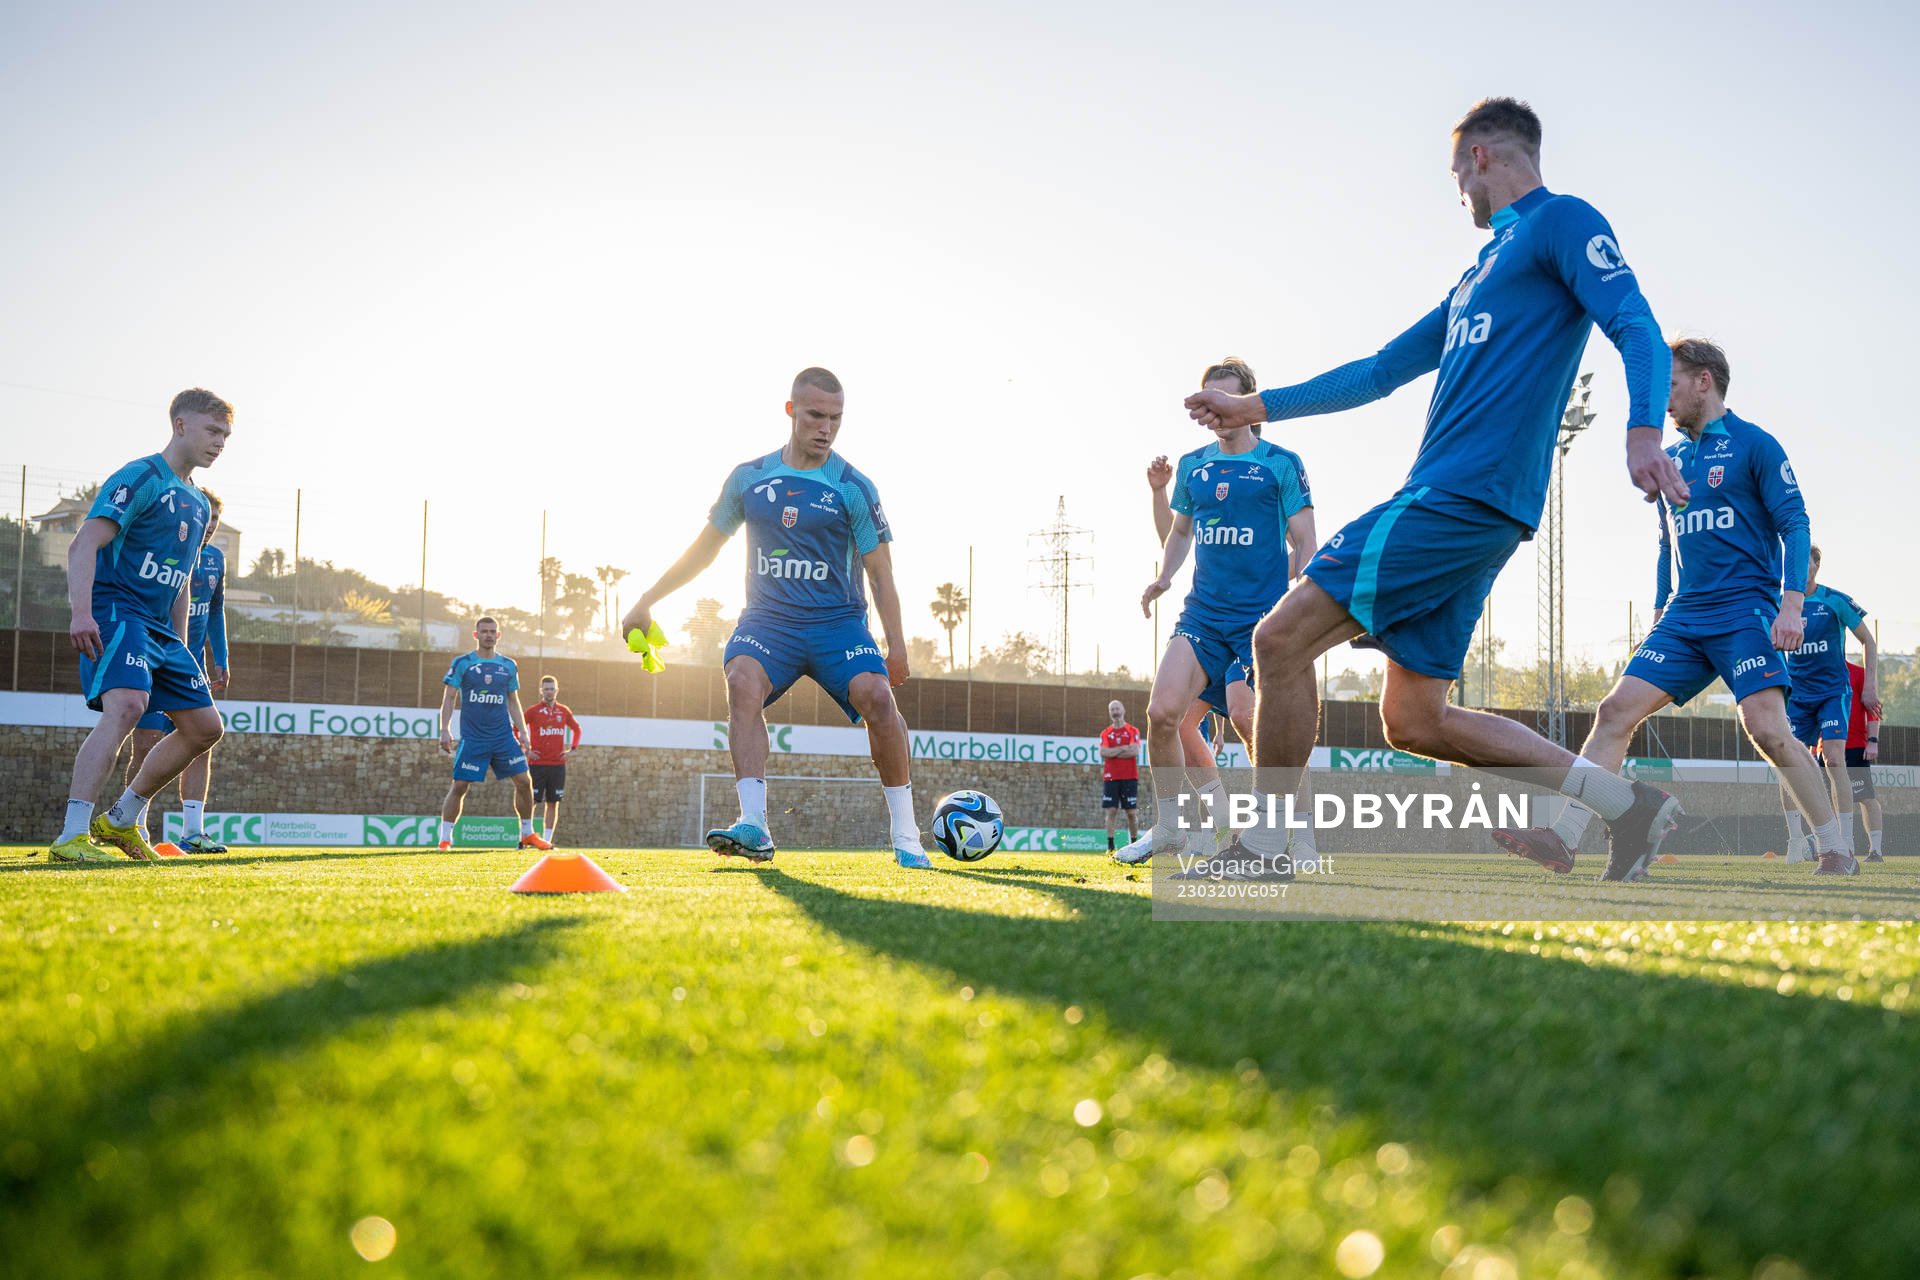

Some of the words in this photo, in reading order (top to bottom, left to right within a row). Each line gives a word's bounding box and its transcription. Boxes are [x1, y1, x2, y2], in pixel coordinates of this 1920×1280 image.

[1675, 506, 1735, 537] ama
[139, 552, 187, 589] bam
[757, 547, 829, 581] bama
[733, 634, 770, 655] bama
[1634, 648, 1666, 664] ama
[469, 689, 504, 705] bama
[310, 709, 441, 738] Footbal
[540, 727, 564, 737] bama
[912, 736, 1035, 762] Marbella
[461, 762, 480, 772] bama
[1871, 766, 1915, 787] otball
[270, 821, 316, 830] Marbella
[461, 823, 505, 833] Marbella
[270, 830, 312, 839] Football
[315, 830, 348, 840] Center
[461, 832, 501, 841] Football
